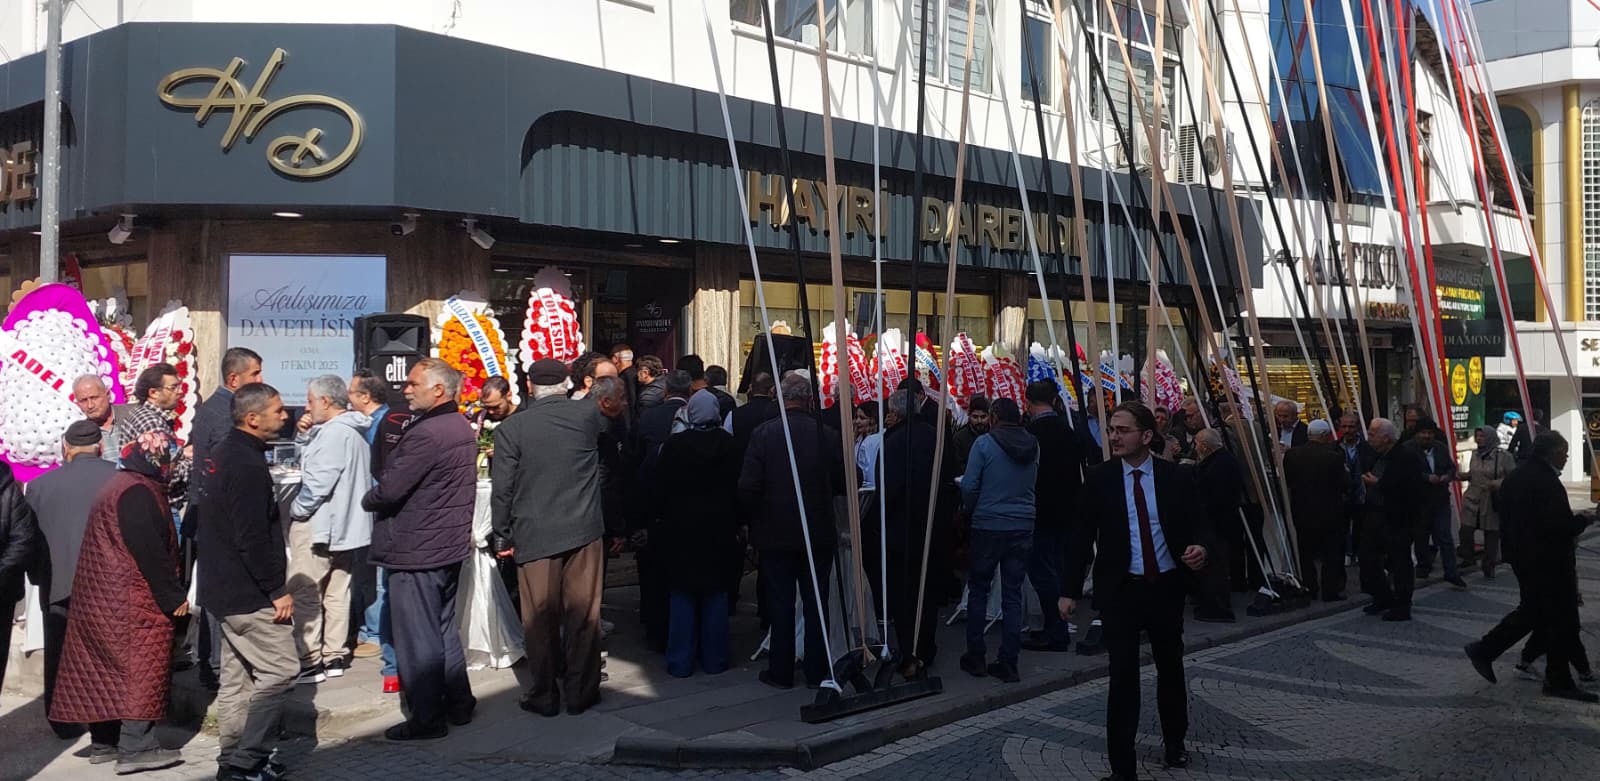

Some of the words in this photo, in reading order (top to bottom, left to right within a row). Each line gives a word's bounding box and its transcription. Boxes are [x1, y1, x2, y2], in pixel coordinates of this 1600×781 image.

[240, 313, 356, 338] DAVETLİSİN
[1443, 335, 1502, 345] DIAMOND
[11, 349, 65, 393] ADEL
[385, 355, 408, 382] elit
